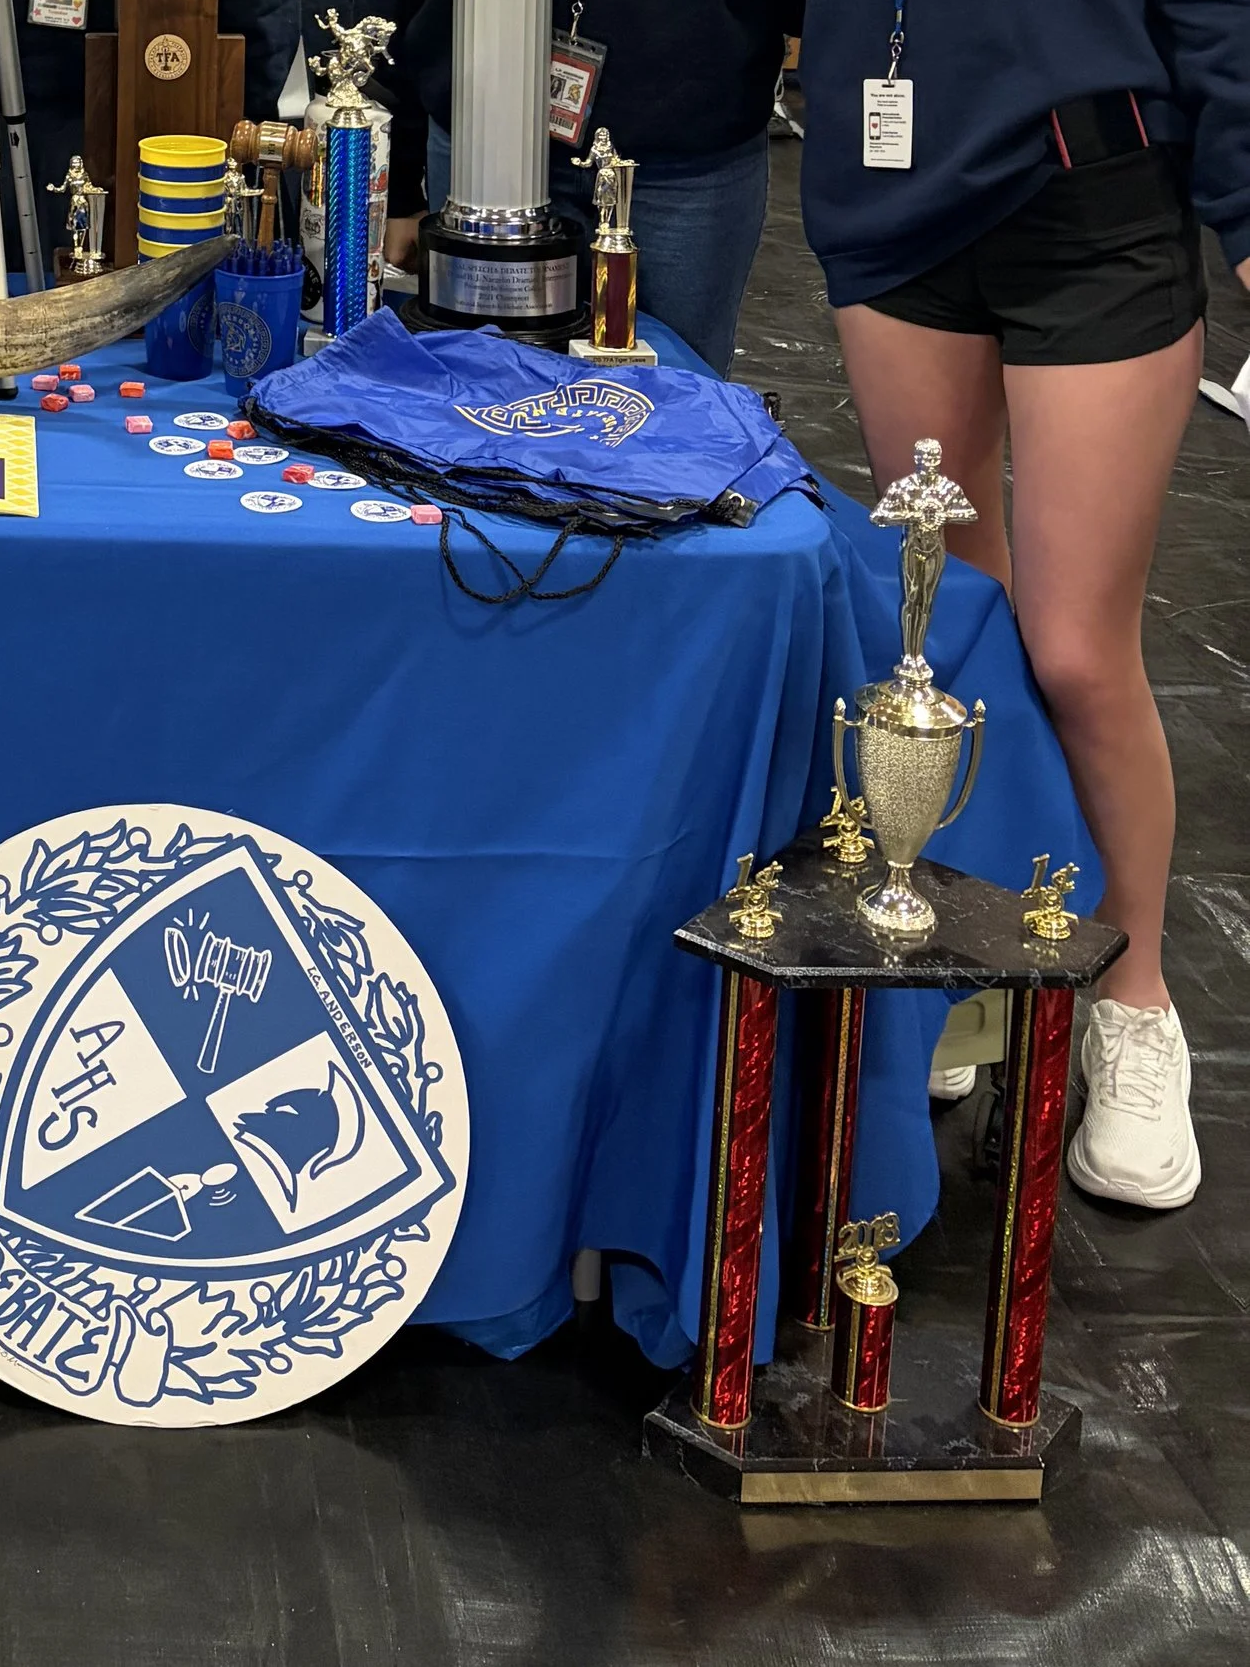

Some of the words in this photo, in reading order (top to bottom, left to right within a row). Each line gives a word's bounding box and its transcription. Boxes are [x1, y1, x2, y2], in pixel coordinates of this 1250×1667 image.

[156, 52, 180, 63] TFA
[318, 990, 373, 1069] ANDERSON
[37, 1019, 127, 1152] AHS
[835, 1211, 901, 1263] 2018
